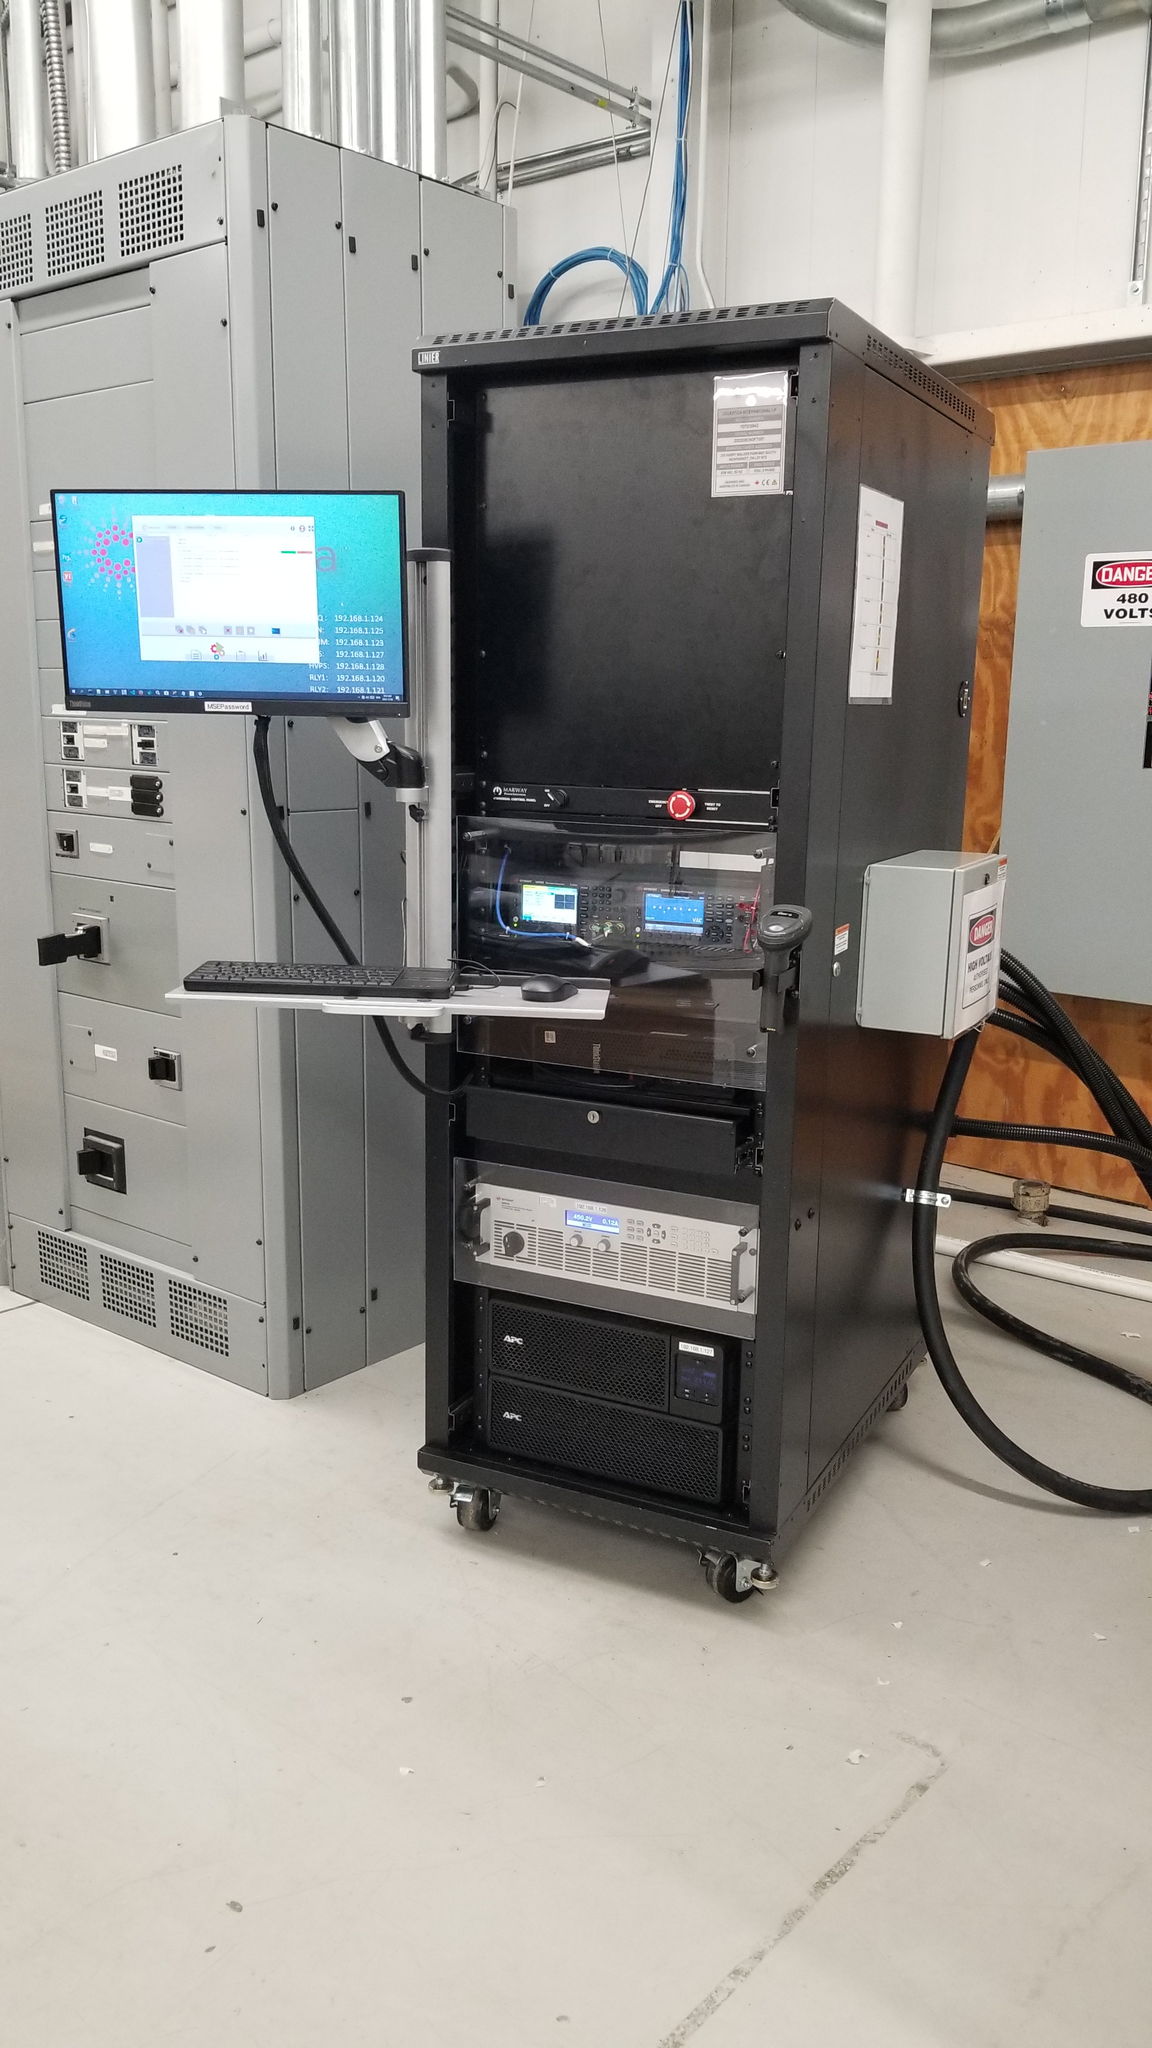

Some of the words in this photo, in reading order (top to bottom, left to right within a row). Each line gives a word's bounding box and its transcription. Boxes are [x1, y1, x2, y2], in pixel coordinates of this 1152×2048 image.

[1116, 592, 1149, 604] 480
[335, 614, 383, 623] 192.168.1.124
[335, 627, 384, 635] 192.168.1.125
[336, 639, 384, 647] 192.168.1.123
[336, 650, 385, 659] 192.168.1.127
[336, 662, 385, 671] 192.168.1.128
[309, 674, 329, 682] RLY1:
[337, 674, 385, 683] 192.168.1.120
[337, 686, 385, 694] 192.168.1.121
[503, 1335, 524, 1345] APC
[502, 1411, 522, 1422] APC
